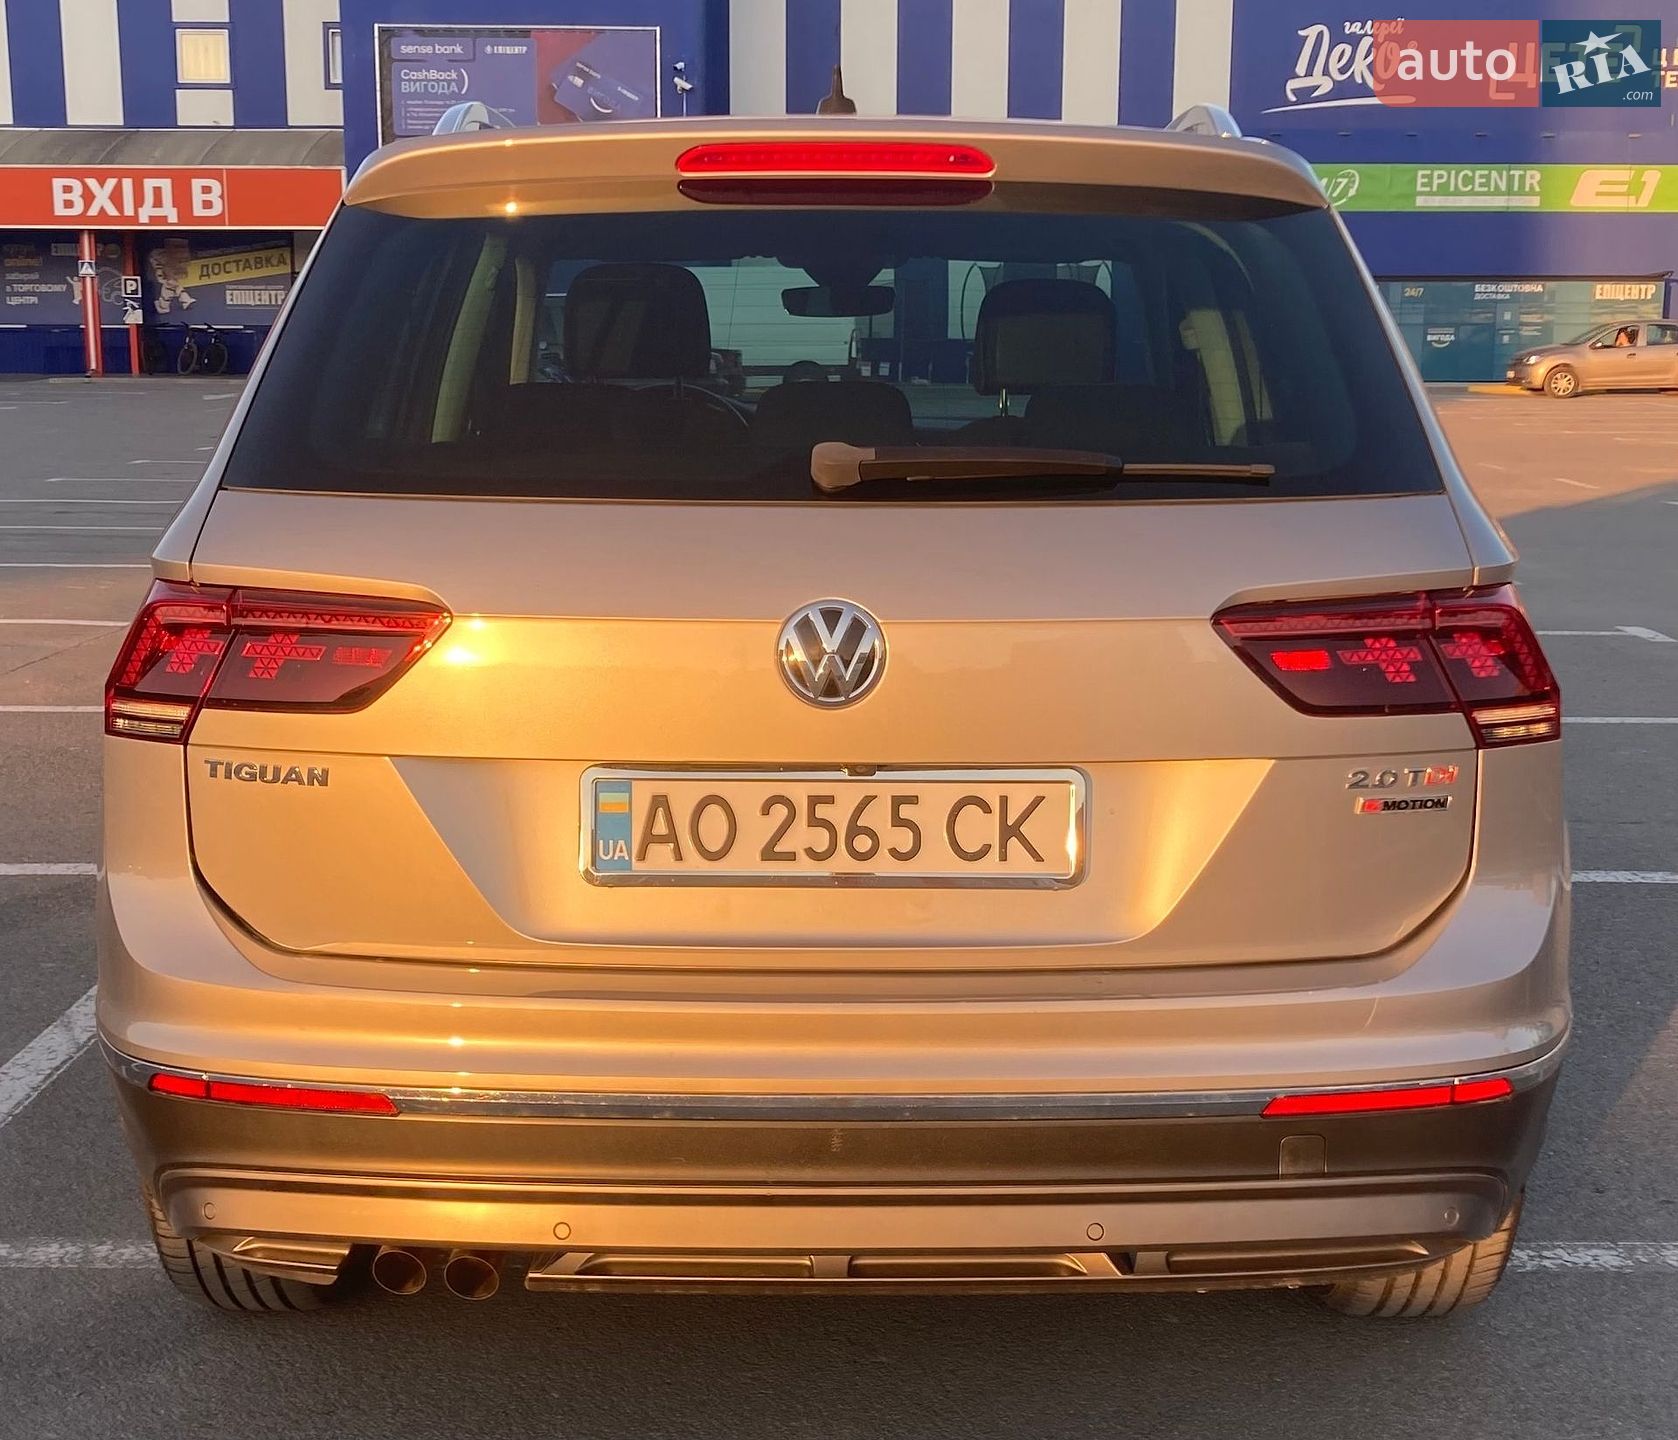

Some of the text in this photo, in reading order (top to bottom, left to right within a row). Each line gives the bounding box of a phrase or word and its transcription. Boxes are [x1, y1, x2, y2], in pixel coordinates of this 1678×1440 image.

[400, 43, 463, 54] sense bank
[400, 69, 458, 80] CashBack
[400, 81, 459, 95] ВИГОДА
[1416, 170, 1541, 192] EPICENTR
[51, 177, 224, 224] ВХІД В
[198, 253, 288, 281] ДОСТАВКА
[126, 280, 137, 293] P
[1474, 284, 1543, 293] БЕЗКОШТОВНА
[204, 759, 329, 787] TIGUAN
[1345, 767, 1398, 789] 2.0
[634, 794, 1046, 862] AO 2565 CK
[598, 839, 629, 861] UA
